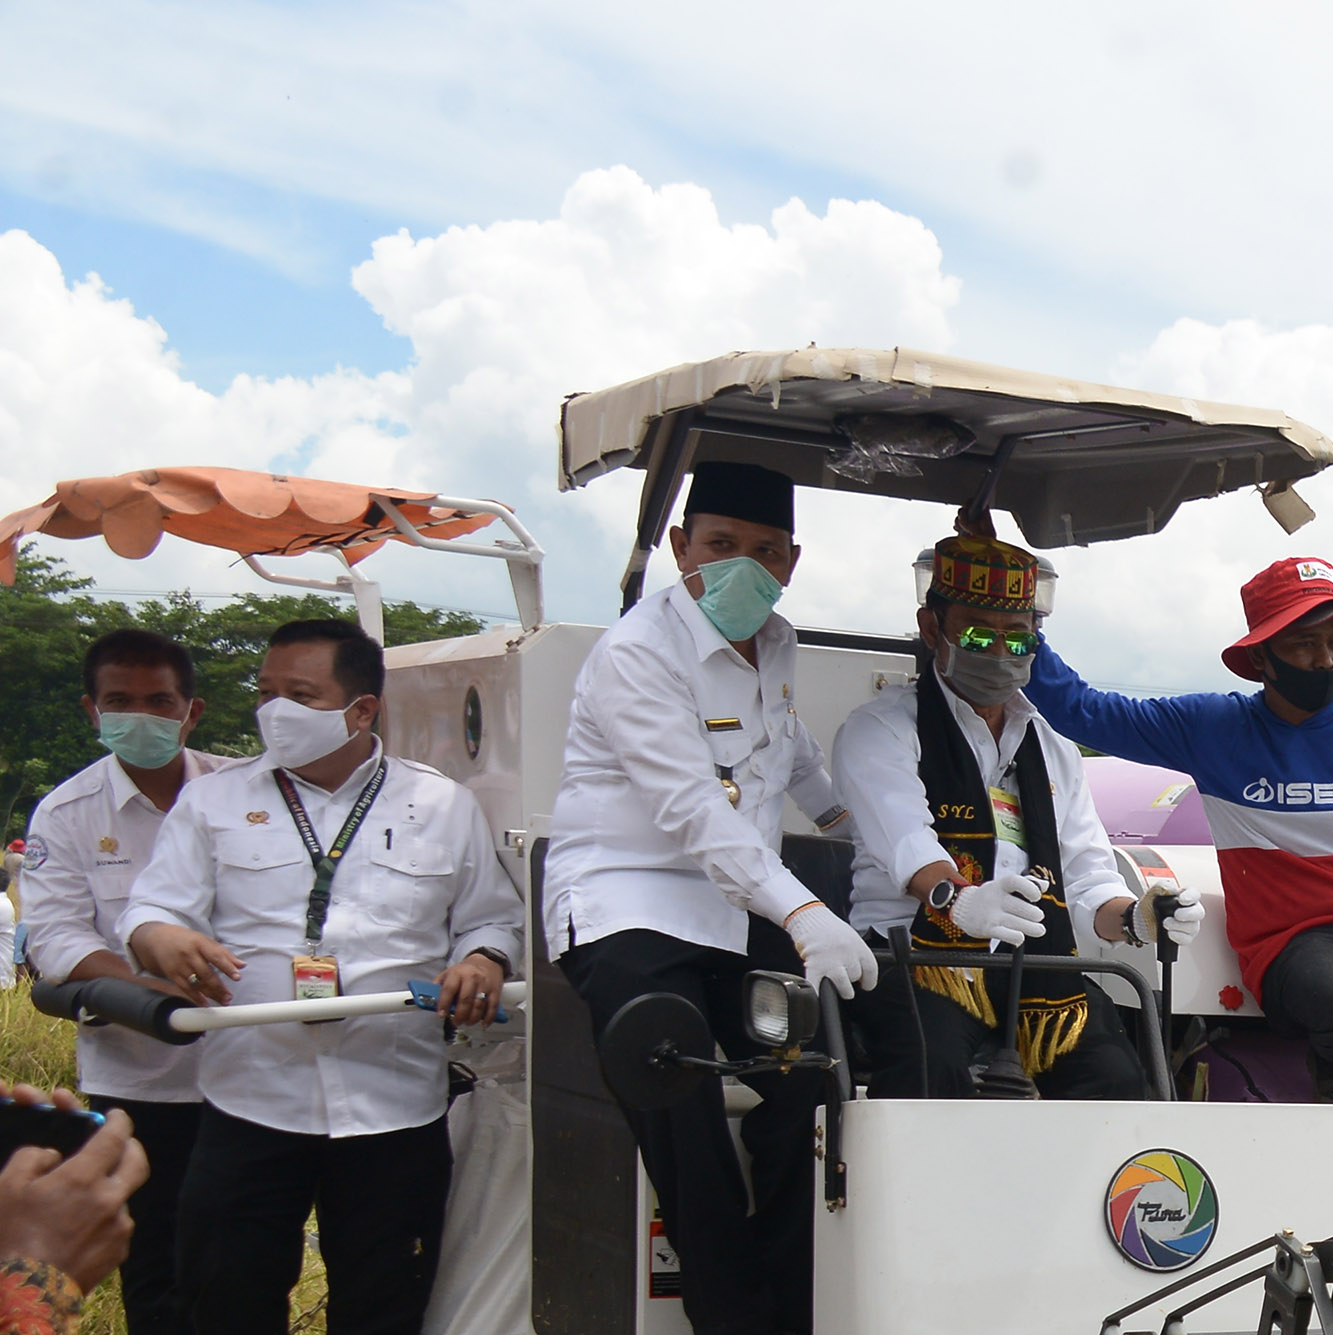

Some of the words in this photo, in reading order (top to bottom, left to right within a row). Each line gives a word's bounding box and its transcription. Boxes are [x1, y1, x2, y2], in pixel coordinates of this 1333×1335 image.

[336, 815, 360, 849] Ministry
[359, 768, 385, 807] Agriculture
[938, 804, 975, 819] SYL
[297, 811, 319, 853] Indonesia
